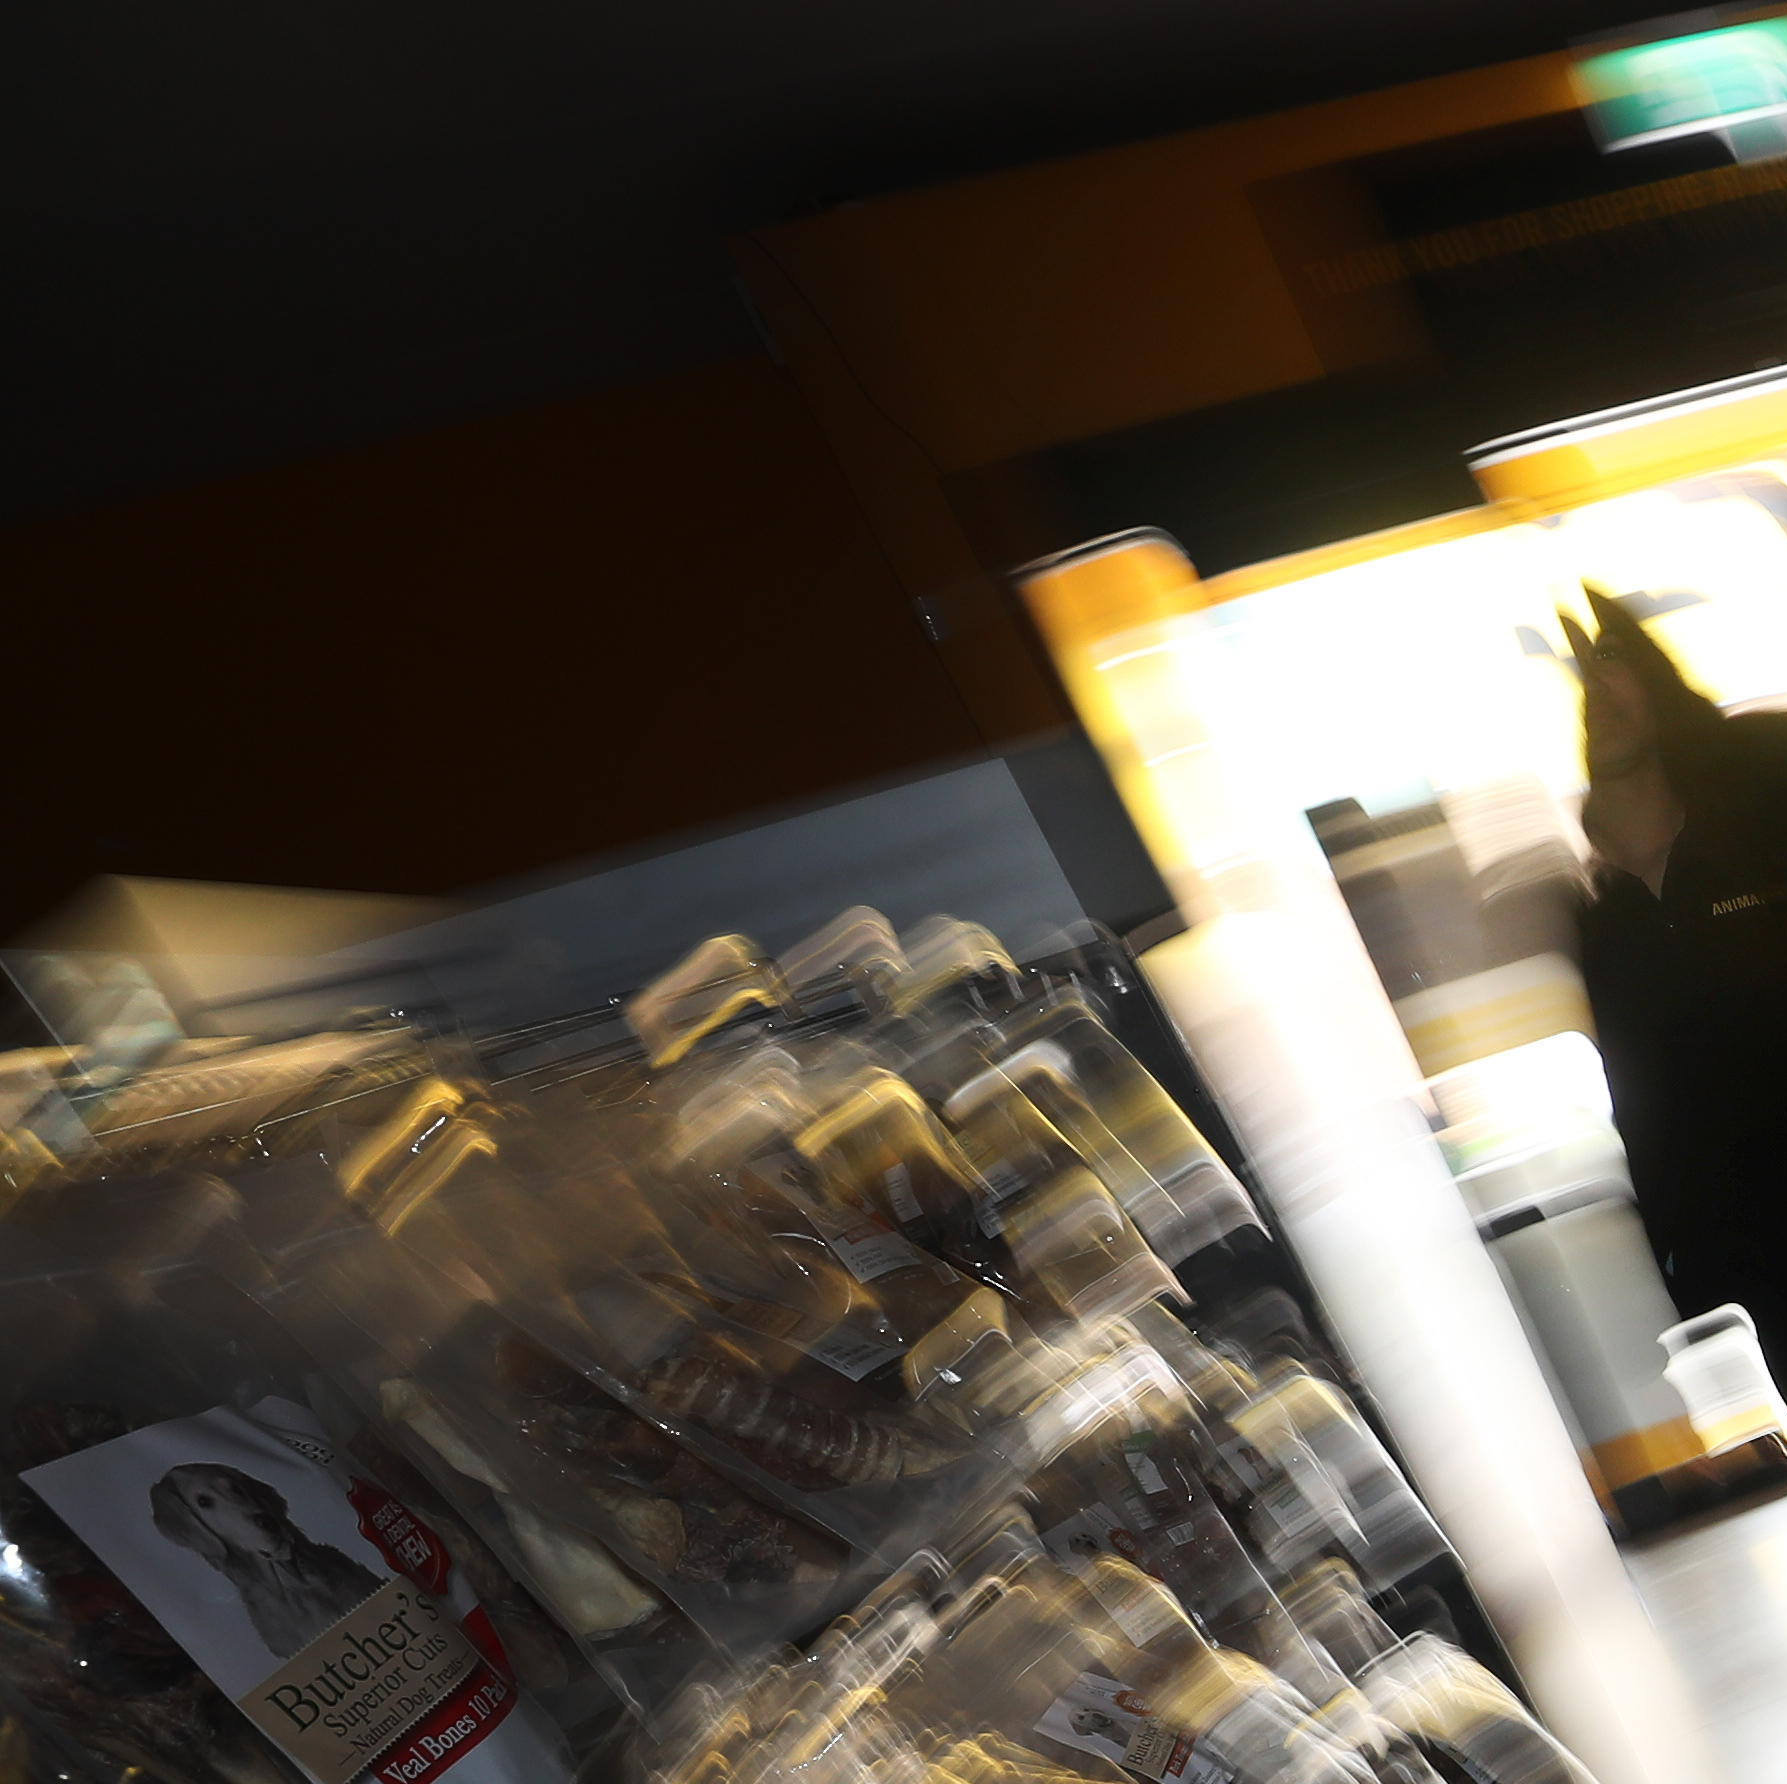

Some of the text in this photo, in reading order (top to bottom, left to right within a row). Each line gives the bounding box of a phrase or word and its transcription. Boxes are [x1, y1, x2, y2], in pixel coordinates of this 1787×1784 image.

[1712, 894, 1766, 916] ANIMA
[265, 1592, 441, 1733] Butcher's
[322, 1631, 449, 1742] Superior Cuts
[349, 1656, 464, 1756] Natural Dog Treats
[419, 1712, 477, 1760] Bones
